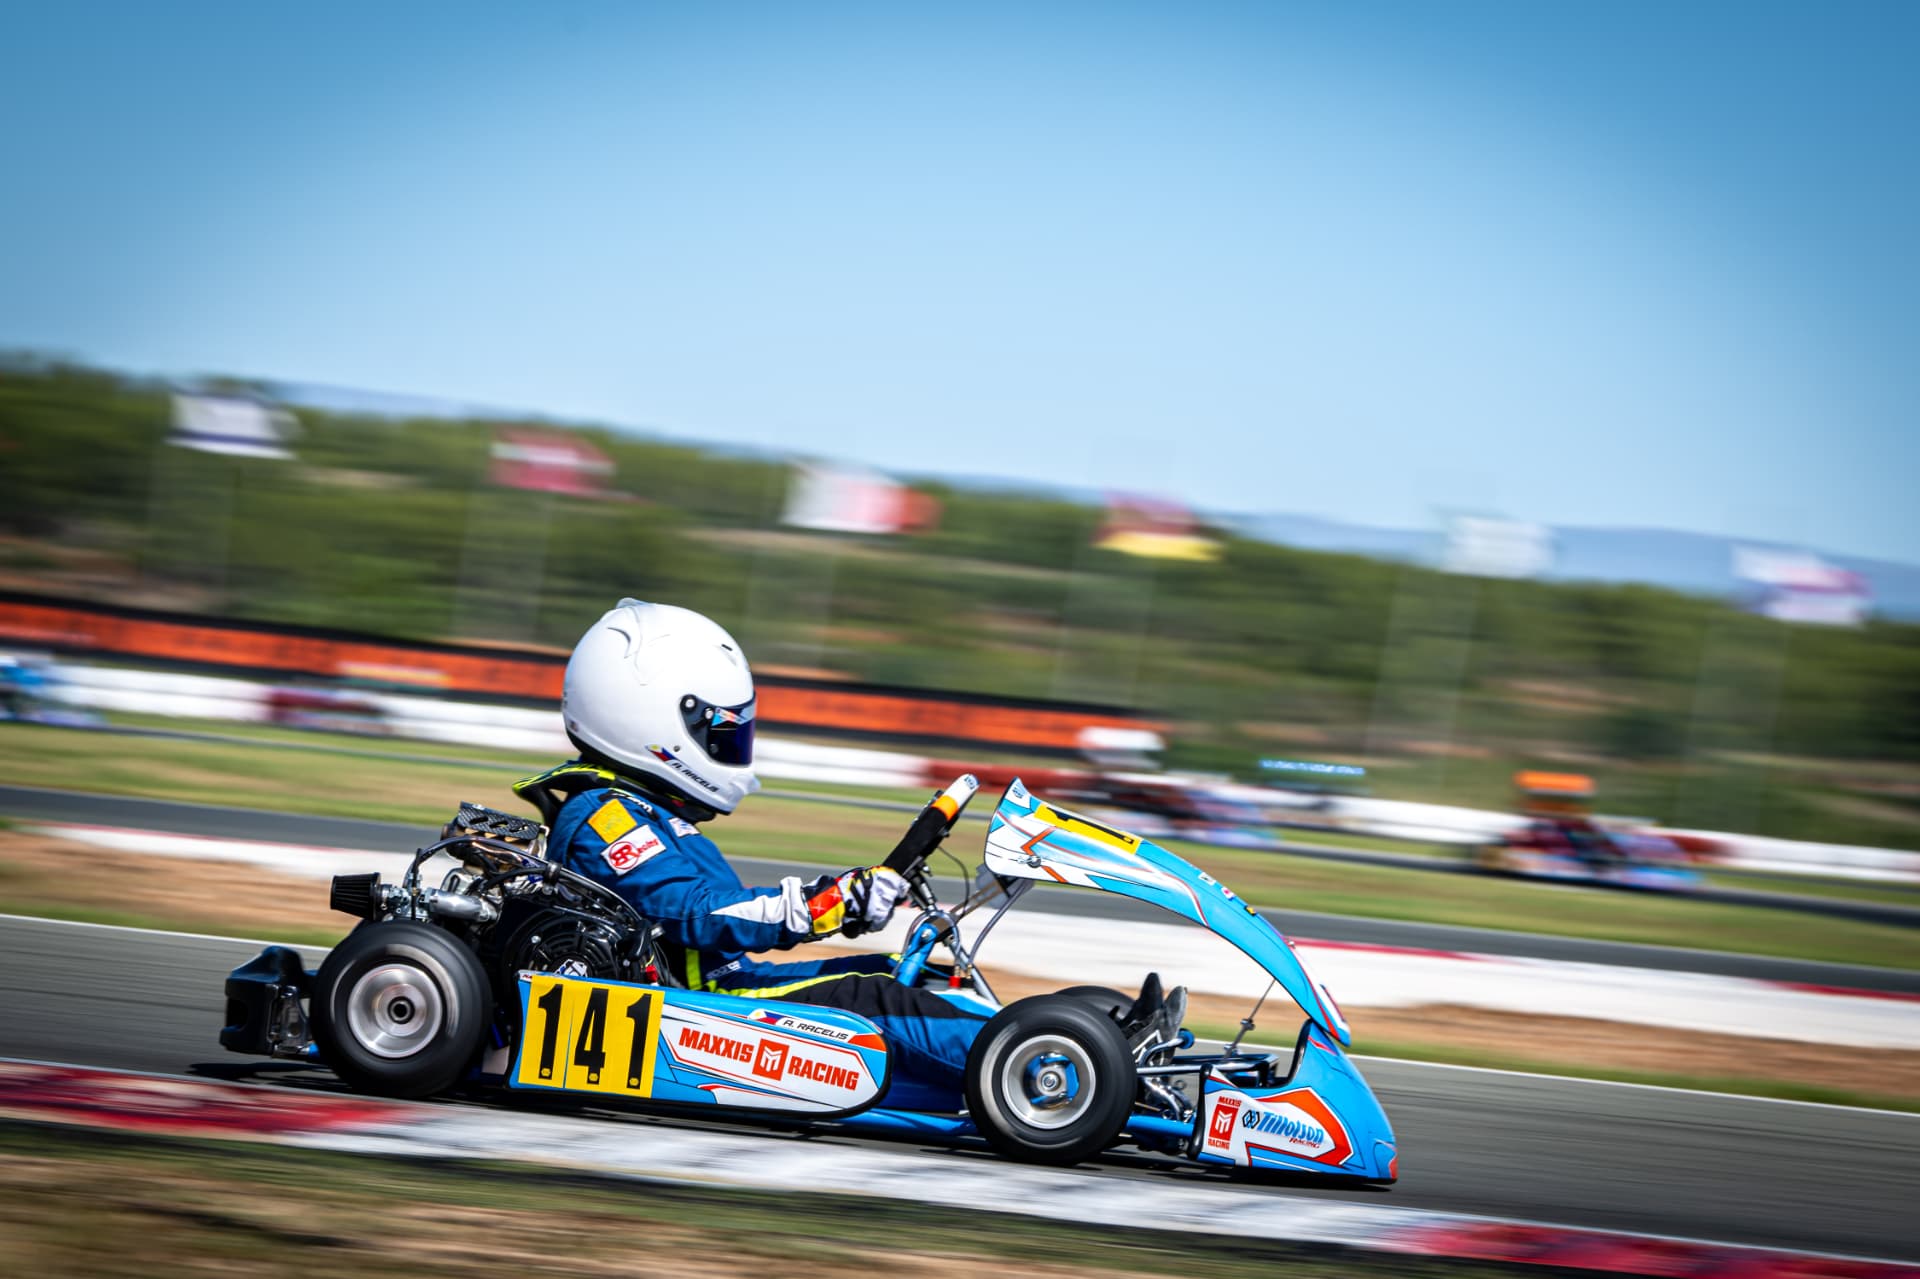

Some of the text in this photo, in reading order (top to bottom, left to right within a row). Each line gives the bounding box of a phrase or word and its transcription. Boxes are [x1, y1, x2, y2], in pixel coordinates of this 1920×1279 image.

[538, 984, 652, 1090] 141
[679, 1027, 753, 1063] MAXXIS
[787, 1056, 859, 1091] RACING
[782, 1018, 849, 1041] A. RACELIS
